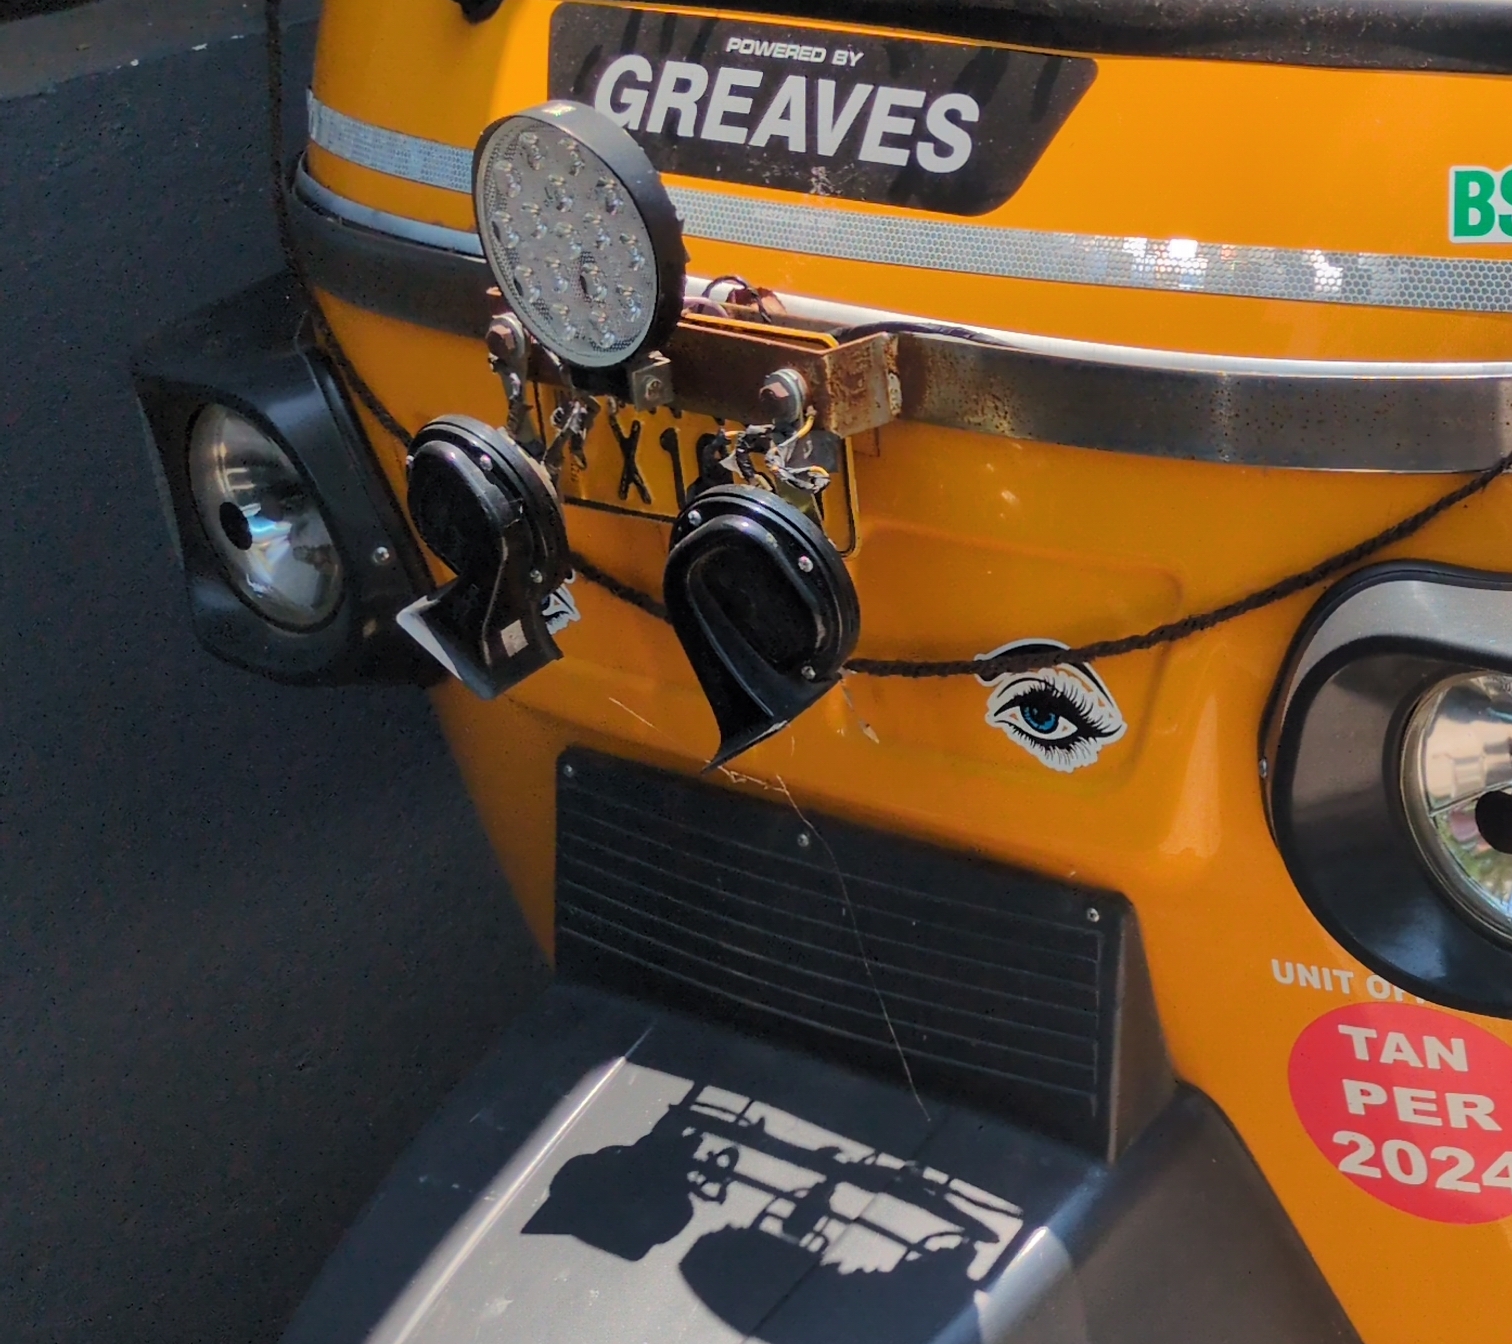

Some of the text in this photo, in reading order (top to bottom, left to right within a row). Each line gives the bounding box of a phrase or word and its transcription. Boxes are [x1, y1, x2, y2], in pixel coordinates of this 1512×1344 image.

[726, 37, 865, 67] POWERED BY
[595, 54, 980, 174] GREAVES
[1271, 958, 1354, 994] UNIT
[1338, 1024, 1469, 1072] TAN
[1342, 1079, 1503, 1131] PER
